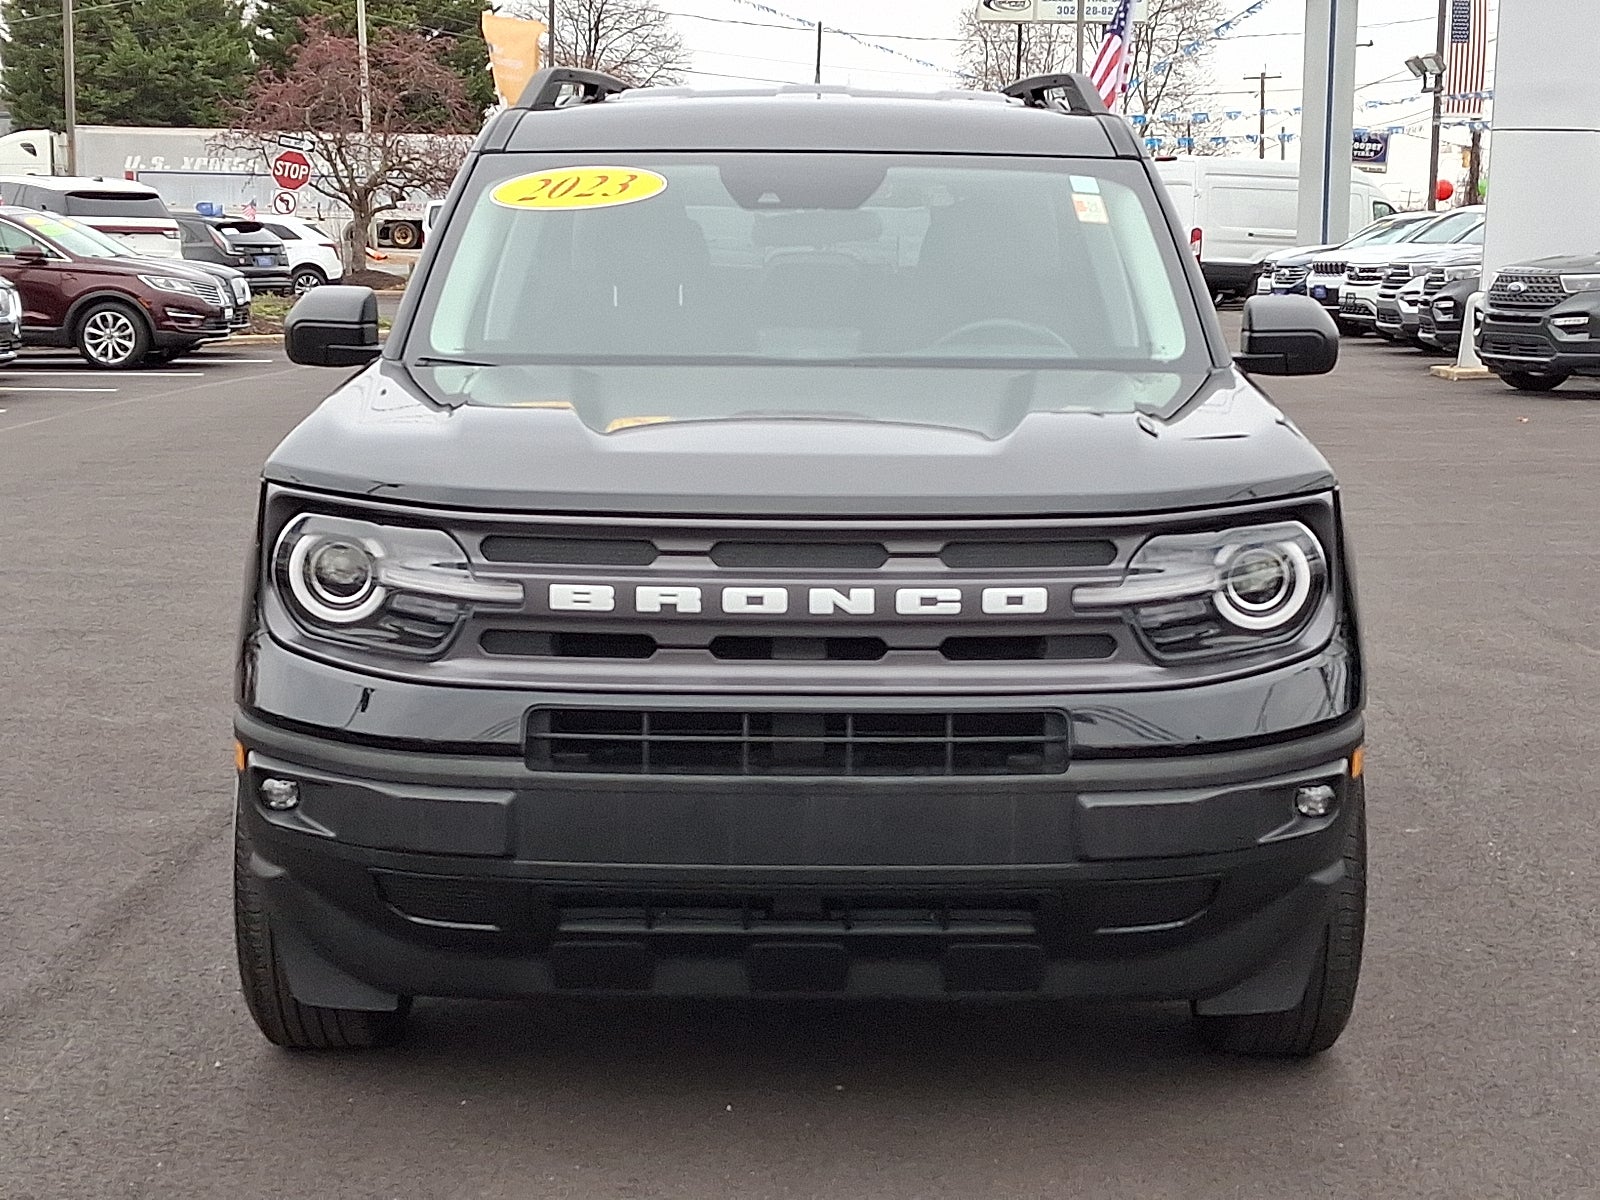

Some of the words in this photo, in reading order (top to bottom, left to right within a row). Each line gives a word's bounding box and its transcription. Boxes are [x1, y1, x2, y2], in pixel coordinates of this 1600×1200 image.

[124, 155, 171, 170] U.S.
[275, 160, 309, 180] STOP
[517, 174, 638, 202] 2023
[549, 583, 1048, 615] BRONCO
